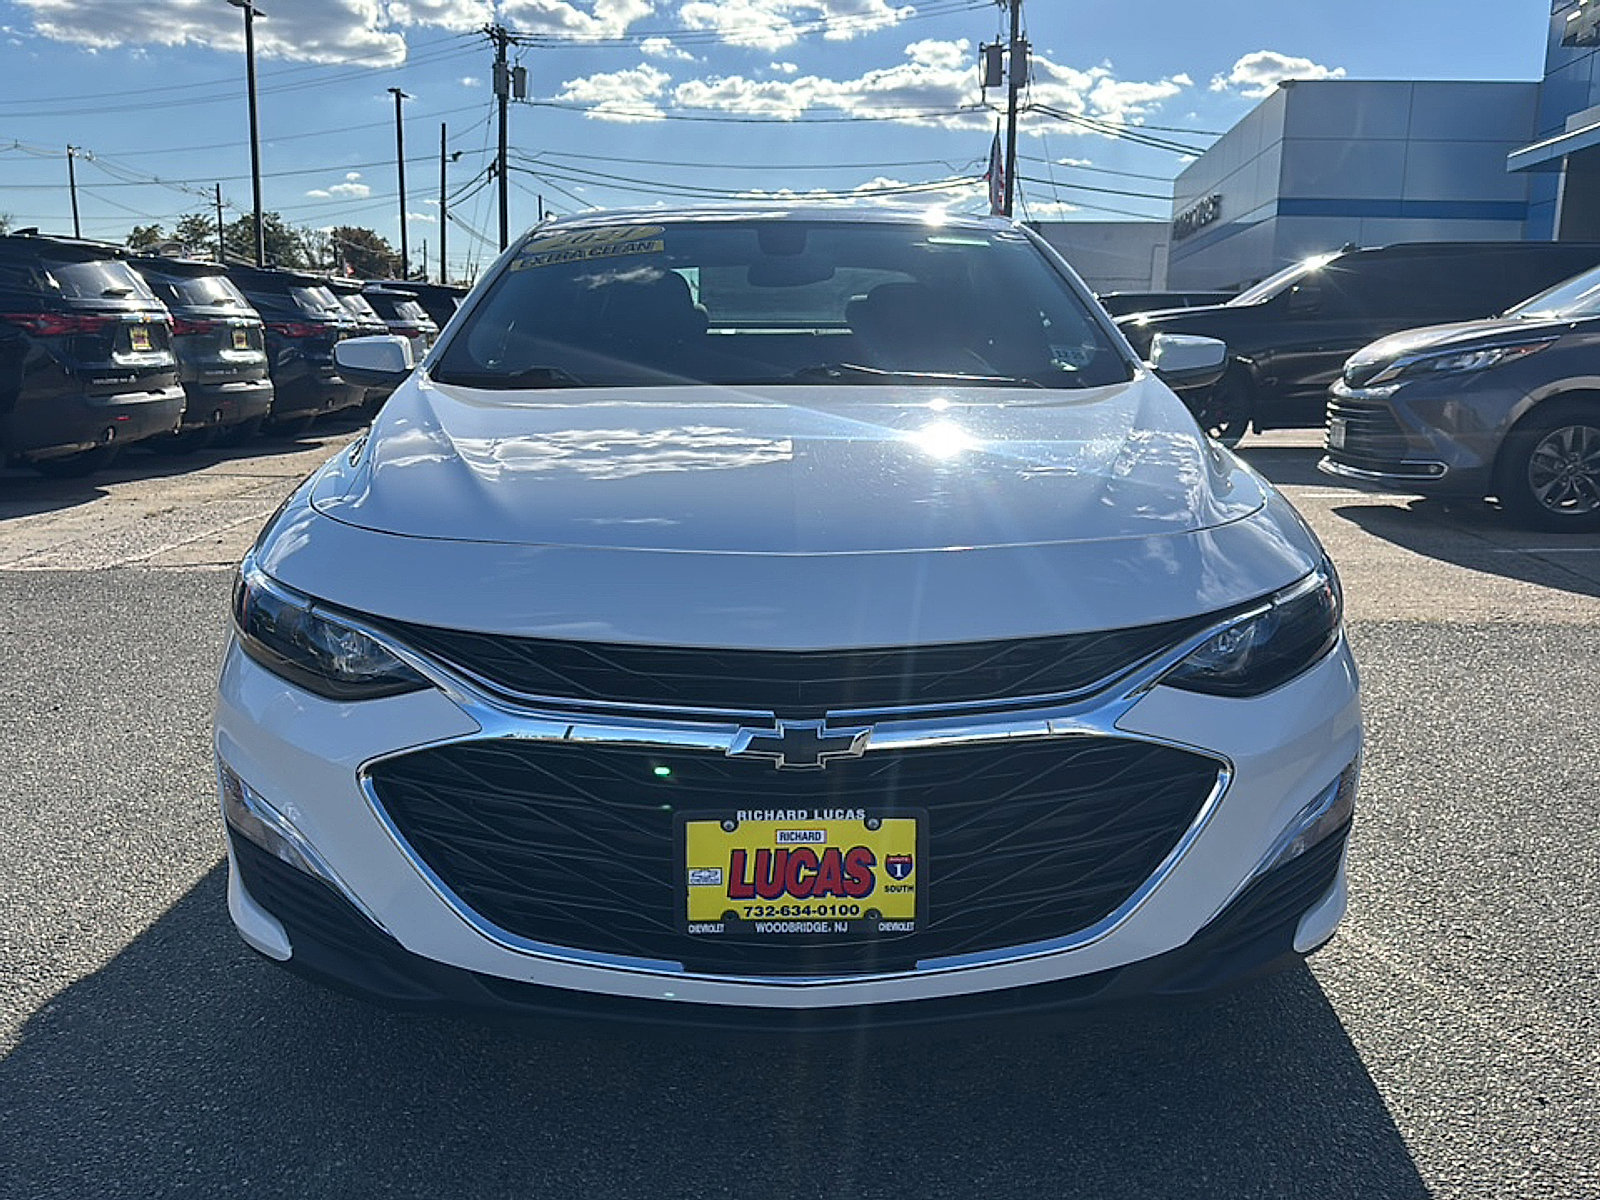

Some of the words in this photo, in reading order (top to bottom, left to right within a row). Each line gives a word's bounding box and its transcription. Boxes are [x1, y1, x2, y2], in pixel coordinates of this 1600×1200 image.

[736, 809, 808, 821] RICHARD
[813, 808, 866, 820] LUCAS
[779, 831, 821, 841] RICHARD
[727, 846, 877, 900] LUCAS
[893, 863, 904, 878] 1
[884, 885, 914, 893] SOUTH
[743, 904, 860, 918] 732-634-0100
[834, 921, 848, 933] NJ
